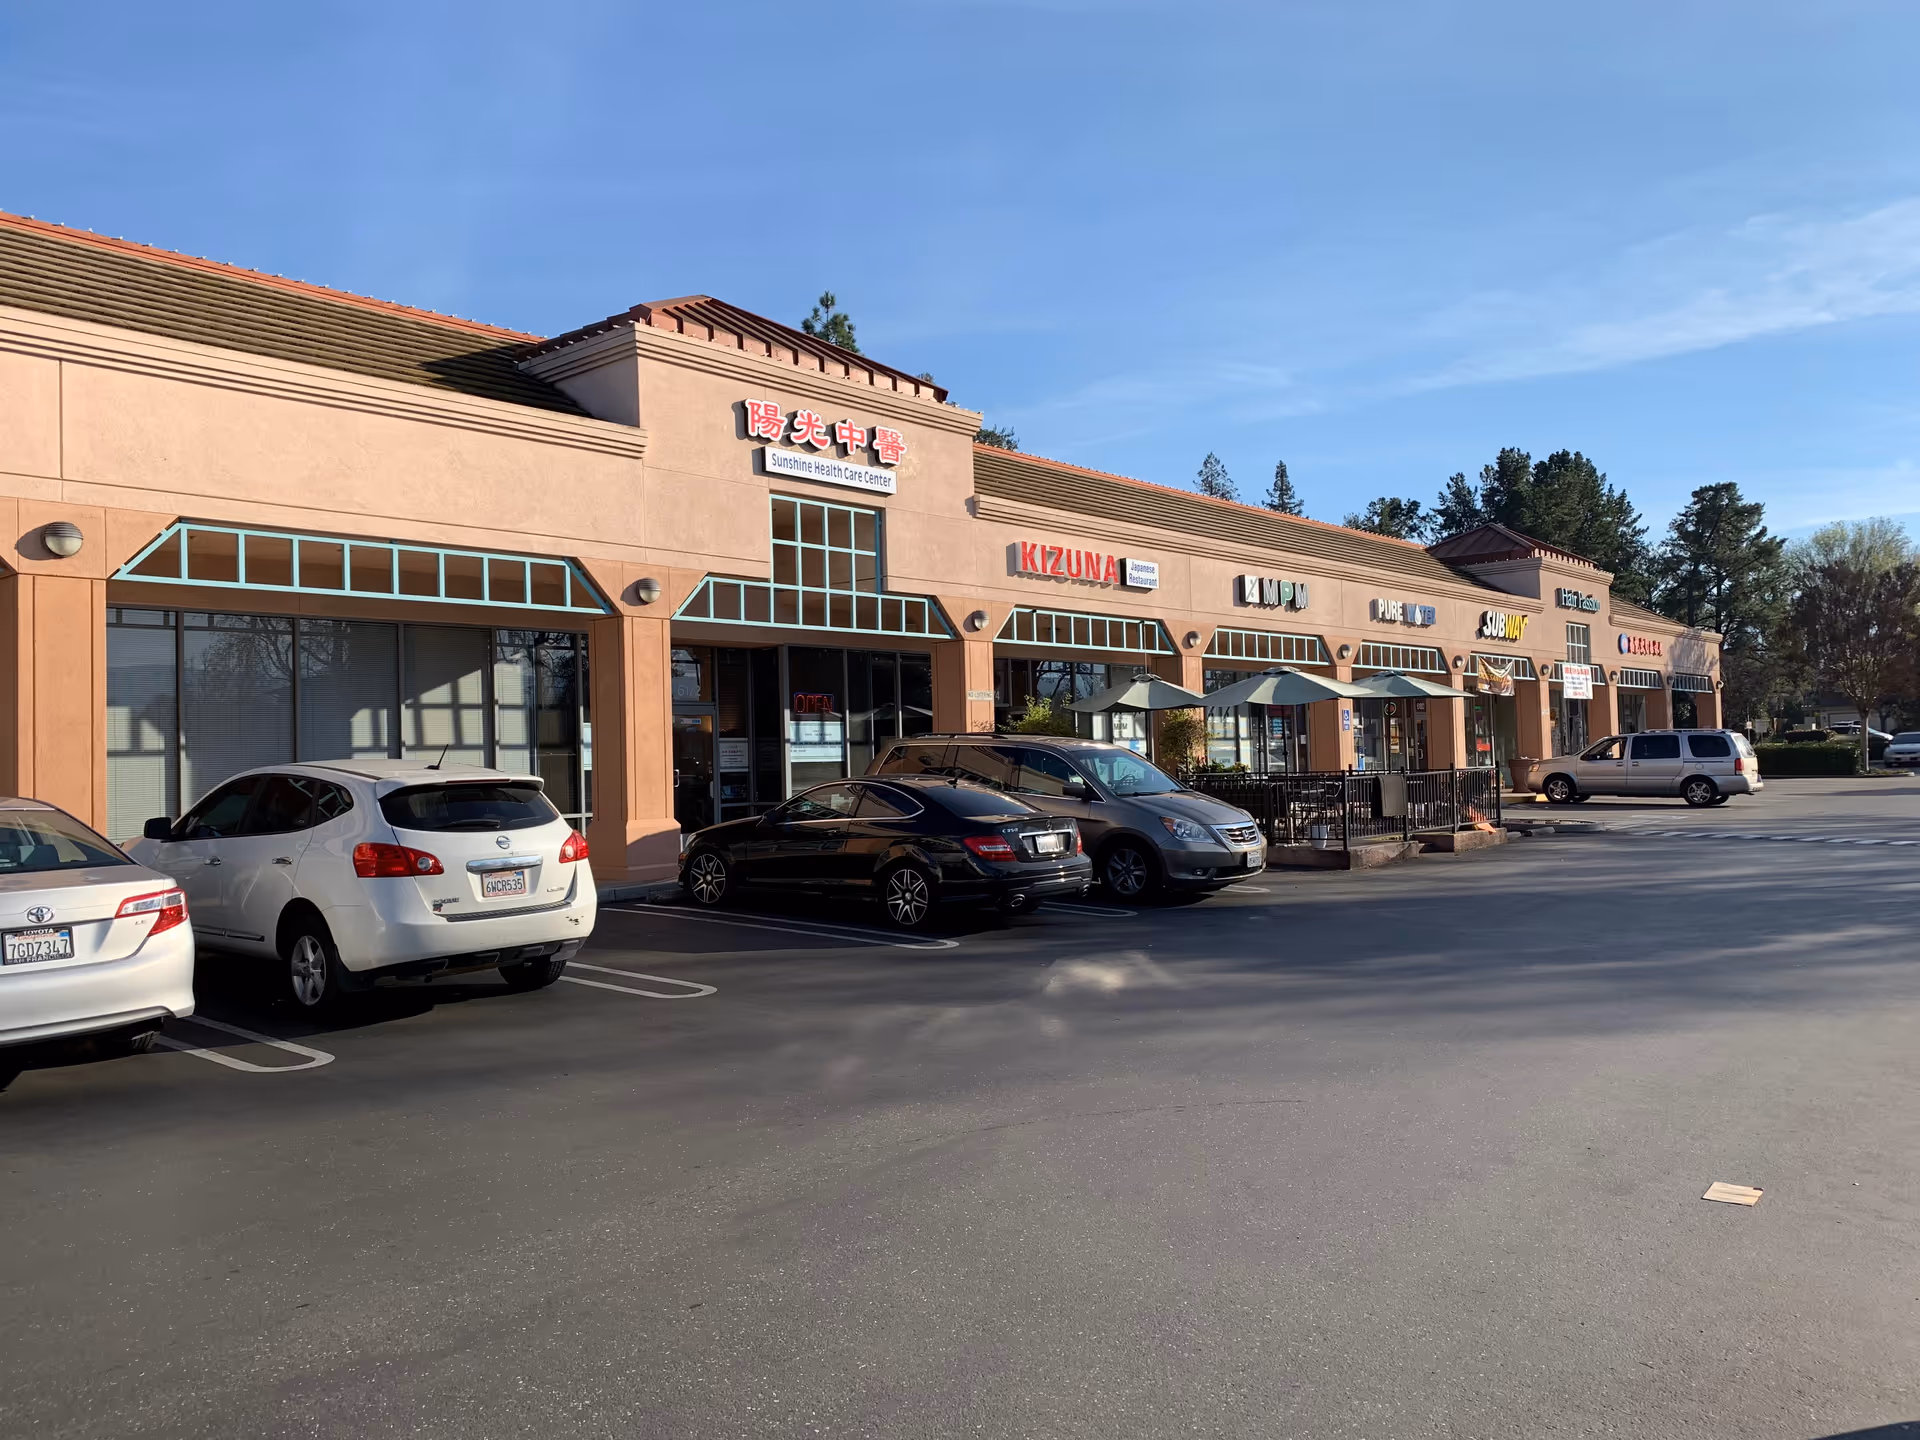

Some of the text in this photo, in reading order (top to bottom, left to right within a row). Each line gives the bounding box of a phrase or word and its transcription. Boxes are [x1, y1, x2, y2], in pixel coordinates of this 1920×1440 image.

[745, 399, 907, 465] 陽光中醫
[771, 453, 892, 487] Sunshine Health Care Center
[1020, 541, 1120, 584] KIZUNA
[1131, 561, 1155, 574] Japanese
[1129, 573, 1158, 587] Restaurant
[1263, 577, 1309, 609] MPM
[1378, 598, 1404, 621] PURE
[1482, 610, 1529, 640] SUBWAY
[796, 694, 833, 714] OPEN
[486, 878, 523, 893] 6WCR535
[23, 928, 54, 936] TOYOTA
[8, 939, 69, 959] 7GDZ347
